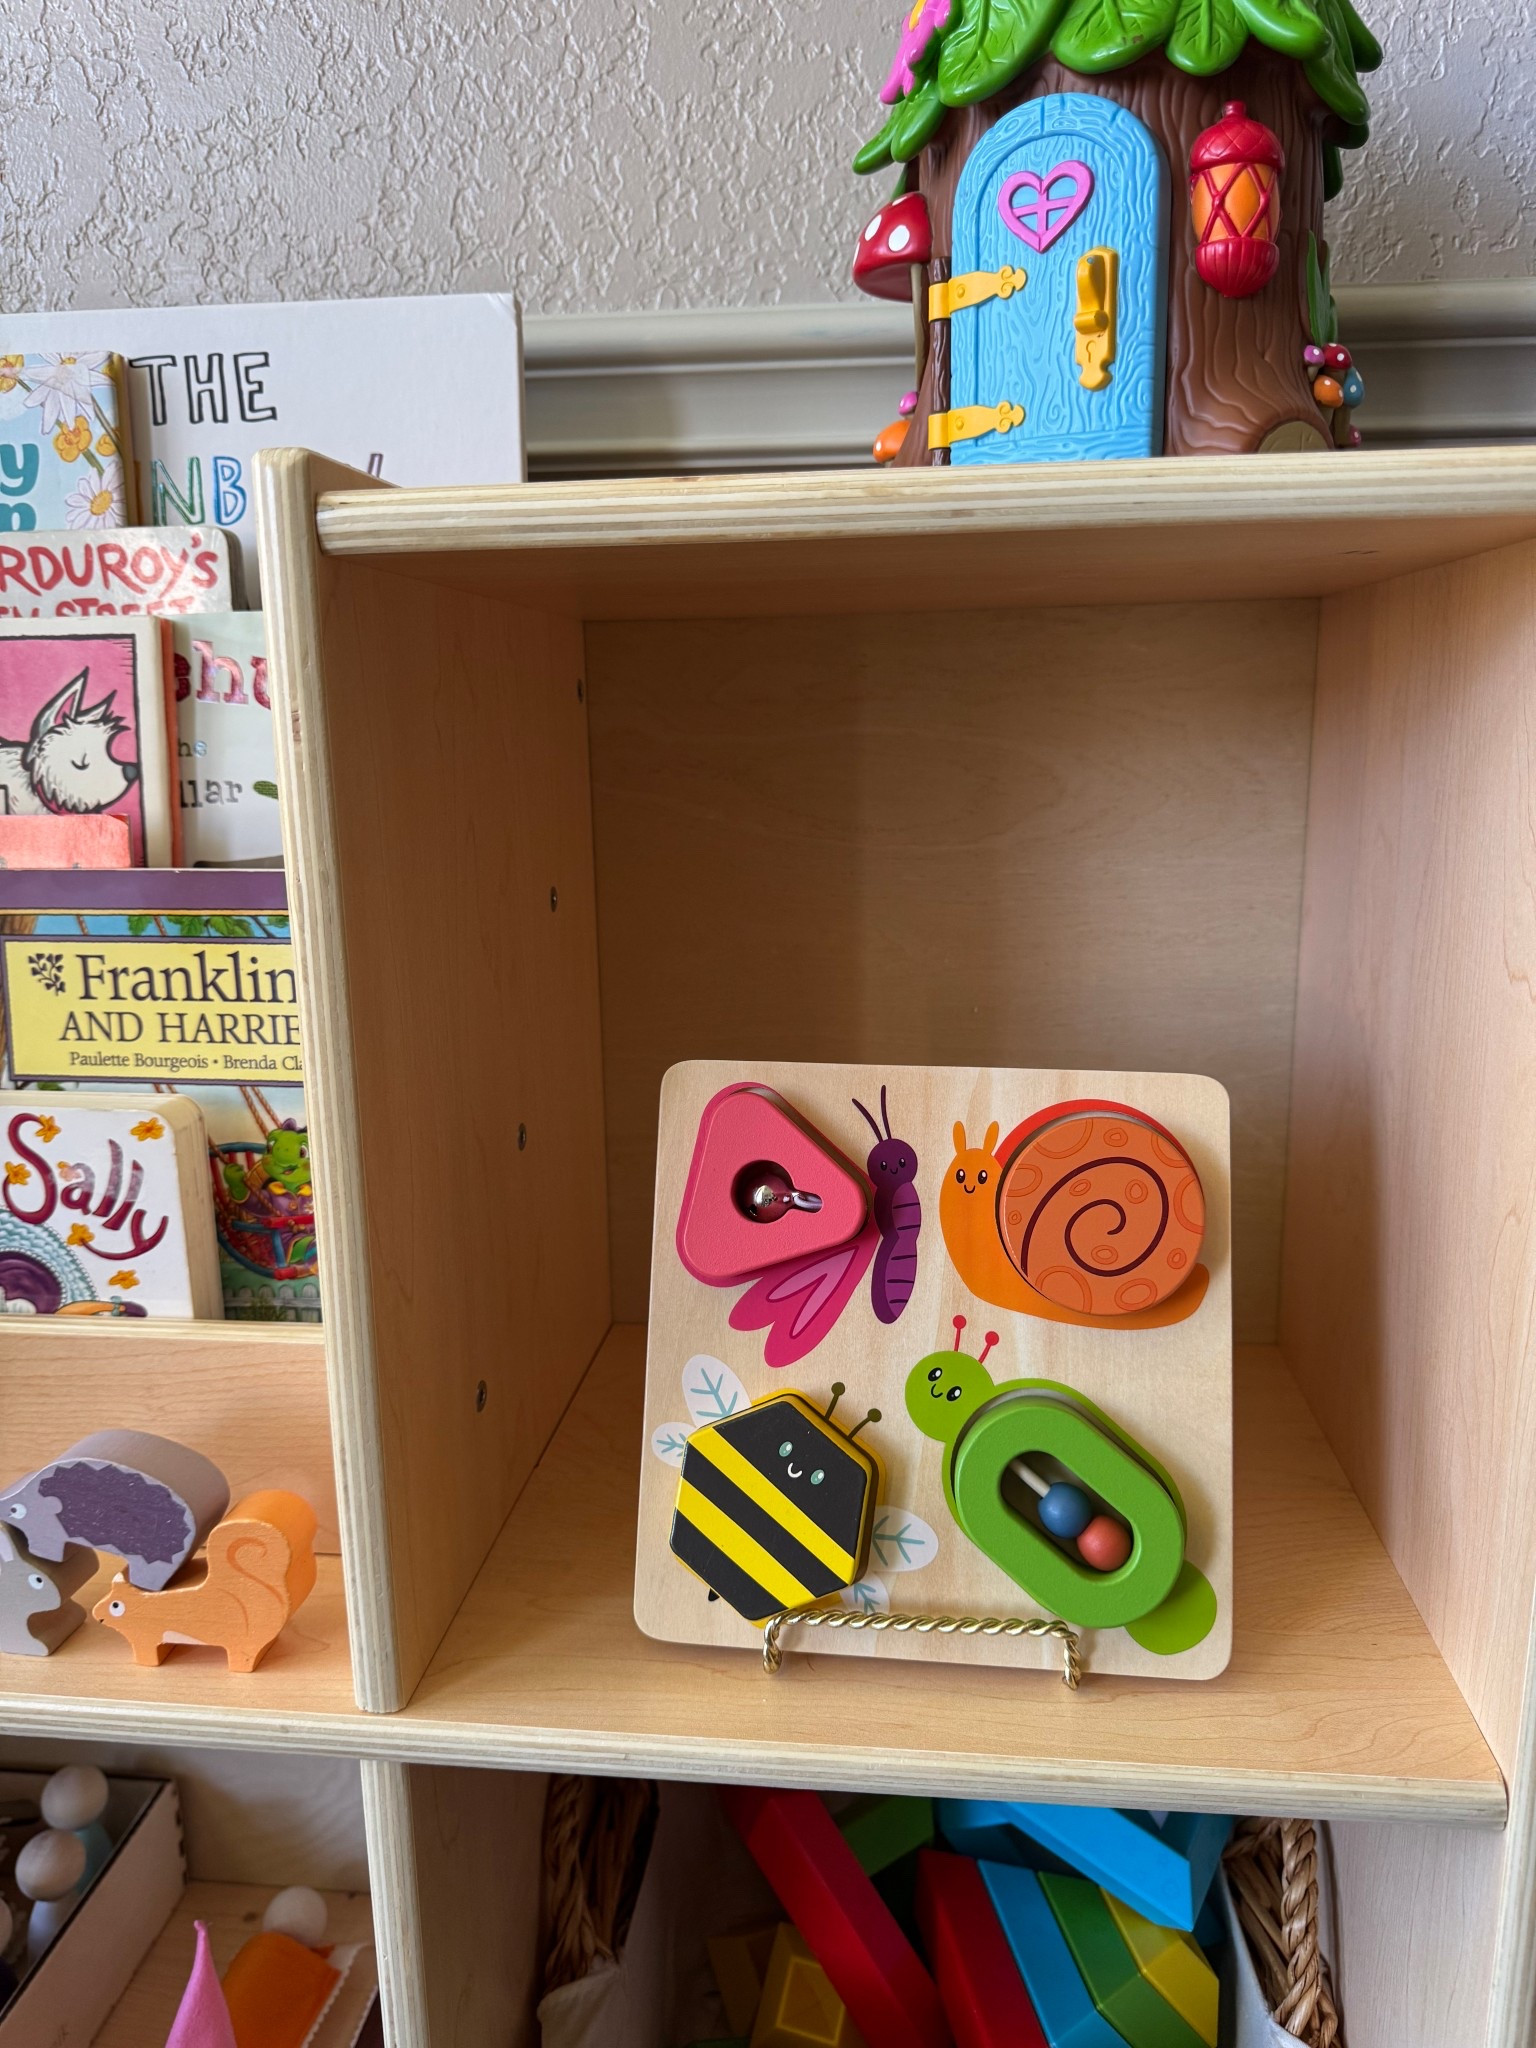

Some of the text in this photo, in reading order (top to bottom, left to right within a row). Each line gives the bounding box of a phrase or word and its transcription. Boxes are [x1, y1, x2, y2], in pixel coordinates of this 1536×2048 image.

[128, 352, 278, 427] THE
[76, 950, 297, 1003] Franklin
[59, 1010, 301, 1046] AND HARRIE
[70, 1051, 130, 1067] Paulette
[134, 1053, 209, 1072] Bourgeois
[223, 1055, 278, 1071] Brenda
[2, 1112, 169, 1260] Sally
